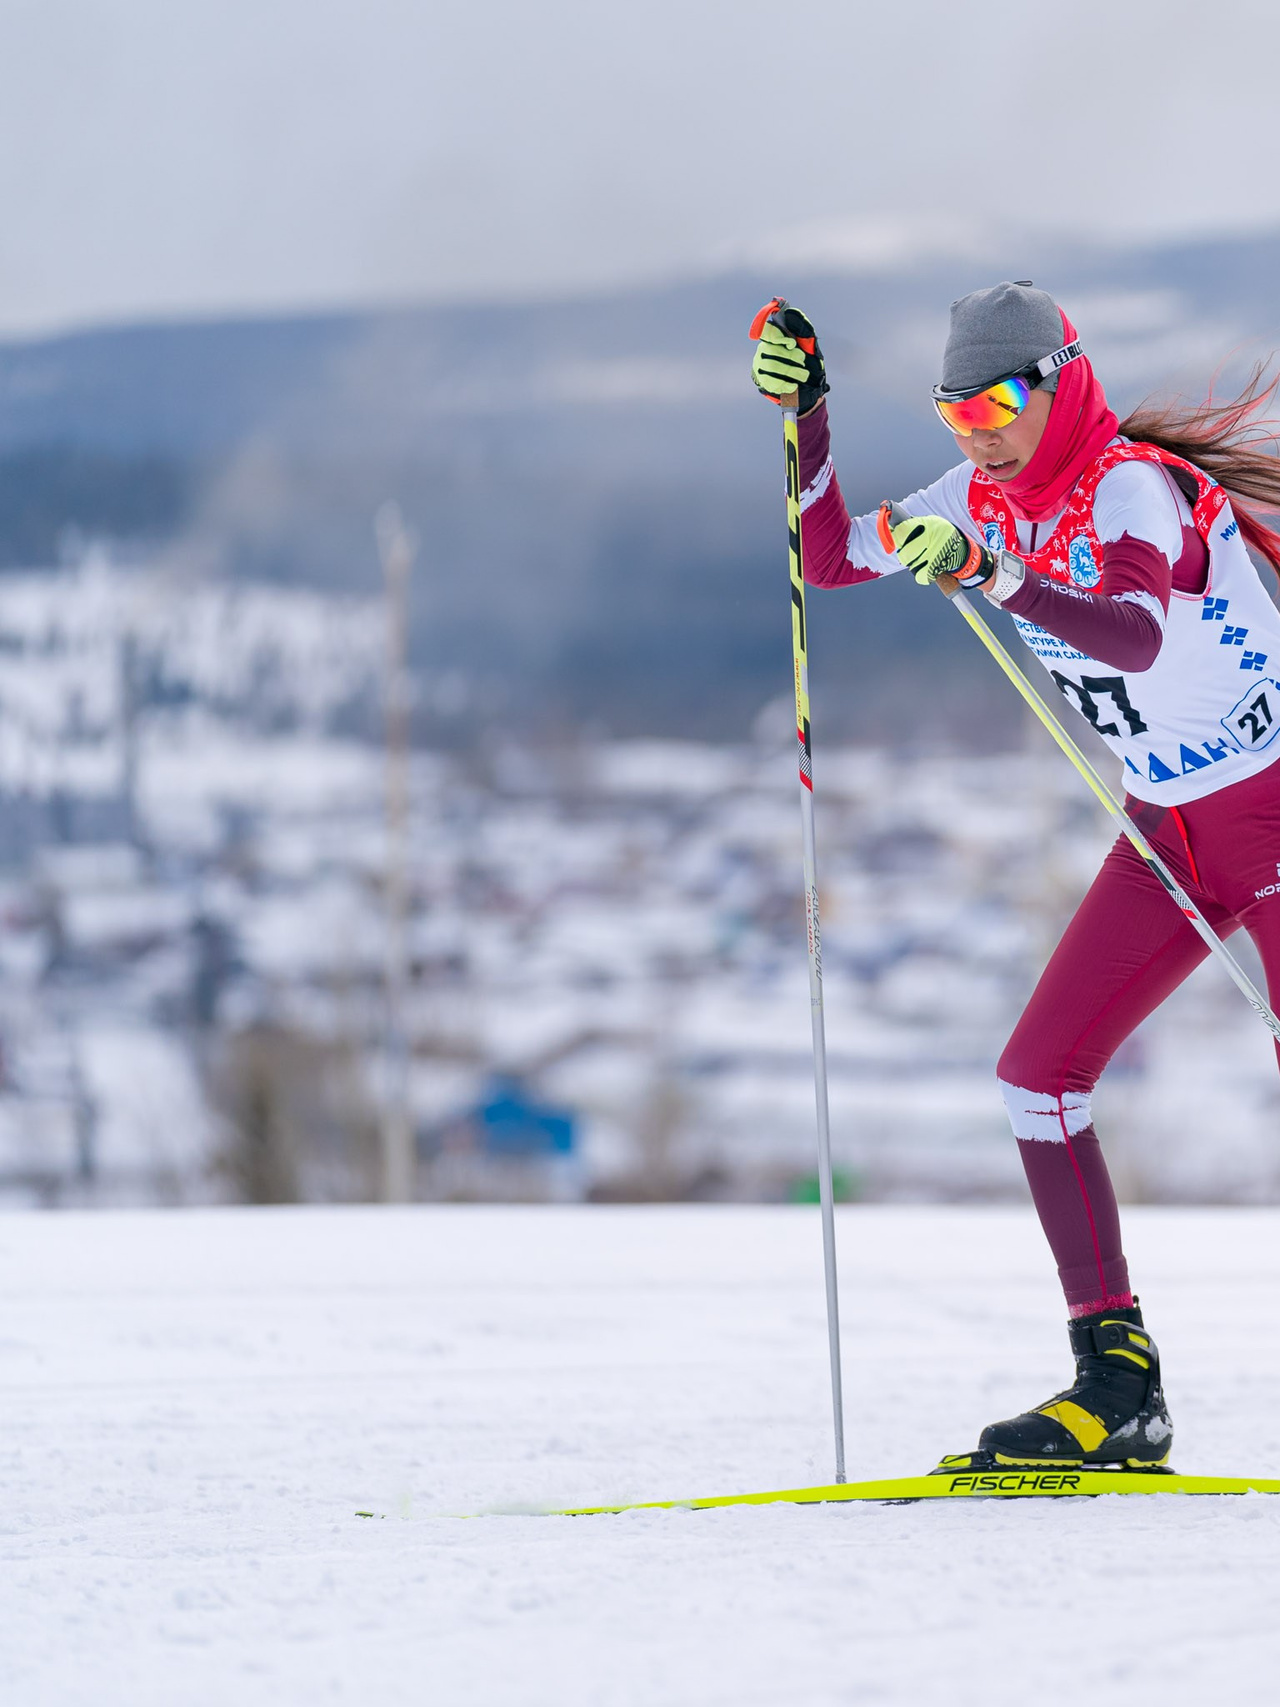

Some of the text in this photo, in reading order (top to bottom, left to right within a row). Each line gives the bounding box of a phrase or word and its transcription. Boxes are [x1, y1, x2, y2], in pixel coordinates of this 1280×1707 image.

[1050, 670, 1149, 739] 27
[1237, 692, 1273, 744] 27
[949, 1474, 1081, 1492] FISCHER
